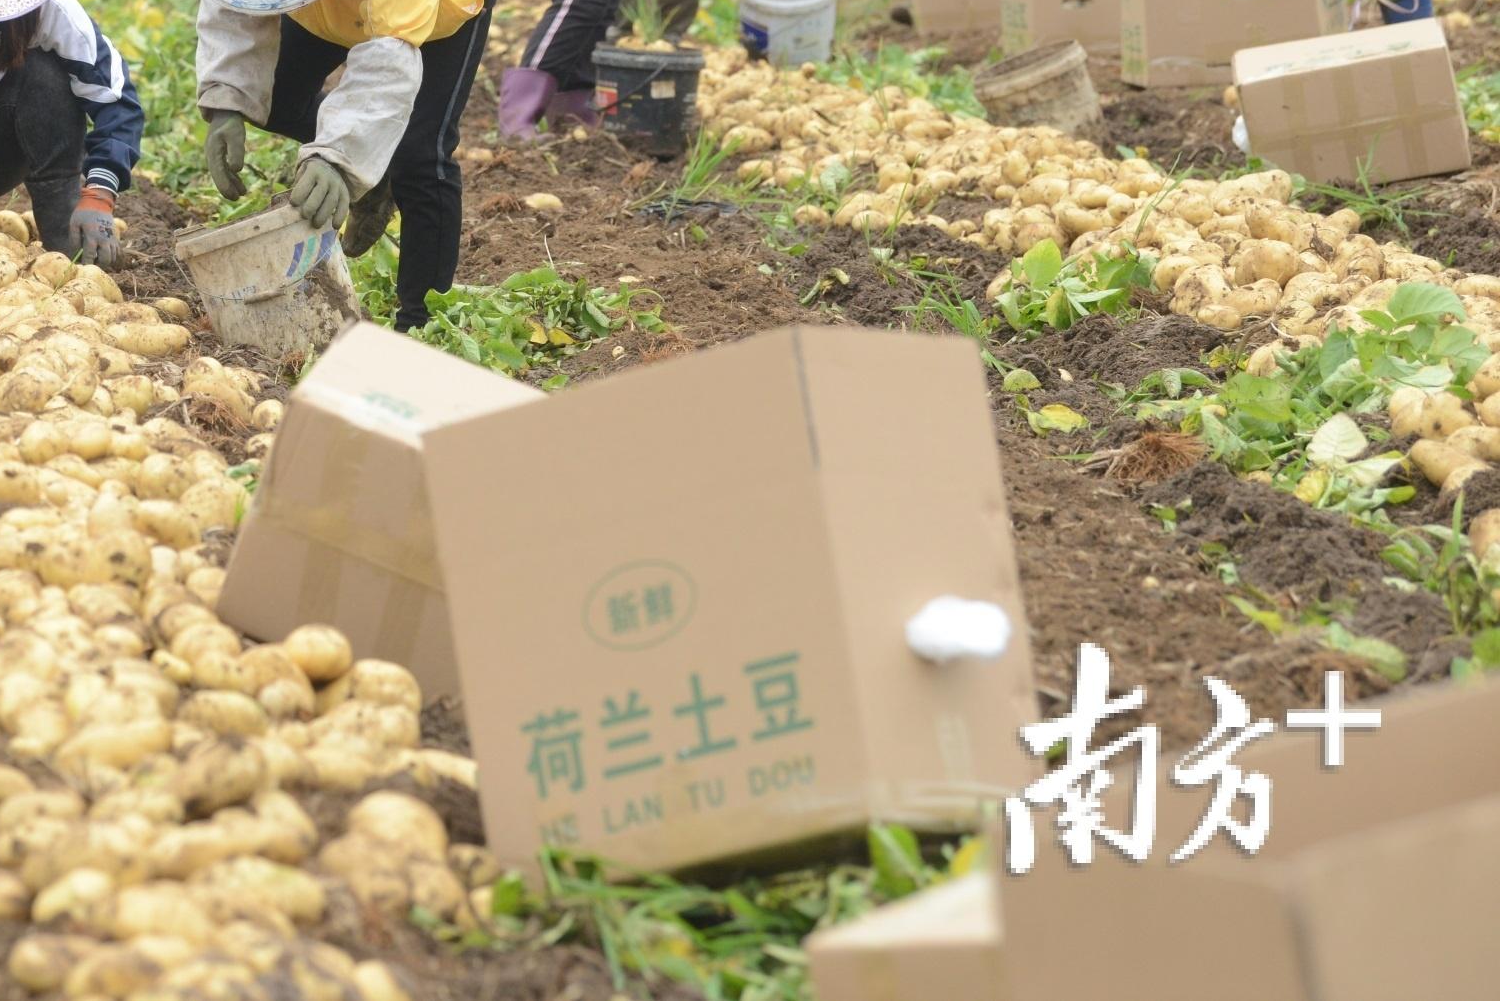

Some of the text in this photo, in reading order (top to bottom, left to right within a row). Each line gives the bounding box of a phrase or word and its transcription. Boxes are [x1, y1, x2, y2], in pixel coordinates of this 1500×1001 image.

[606, 580, 675, 635] 新鲜
[519, 651, 816, 799] 荷兰土豆
[602, 795, 665, 835] LAN
[685, 778, 726, 811] TU
[746, 754, 817, 796] DOU
